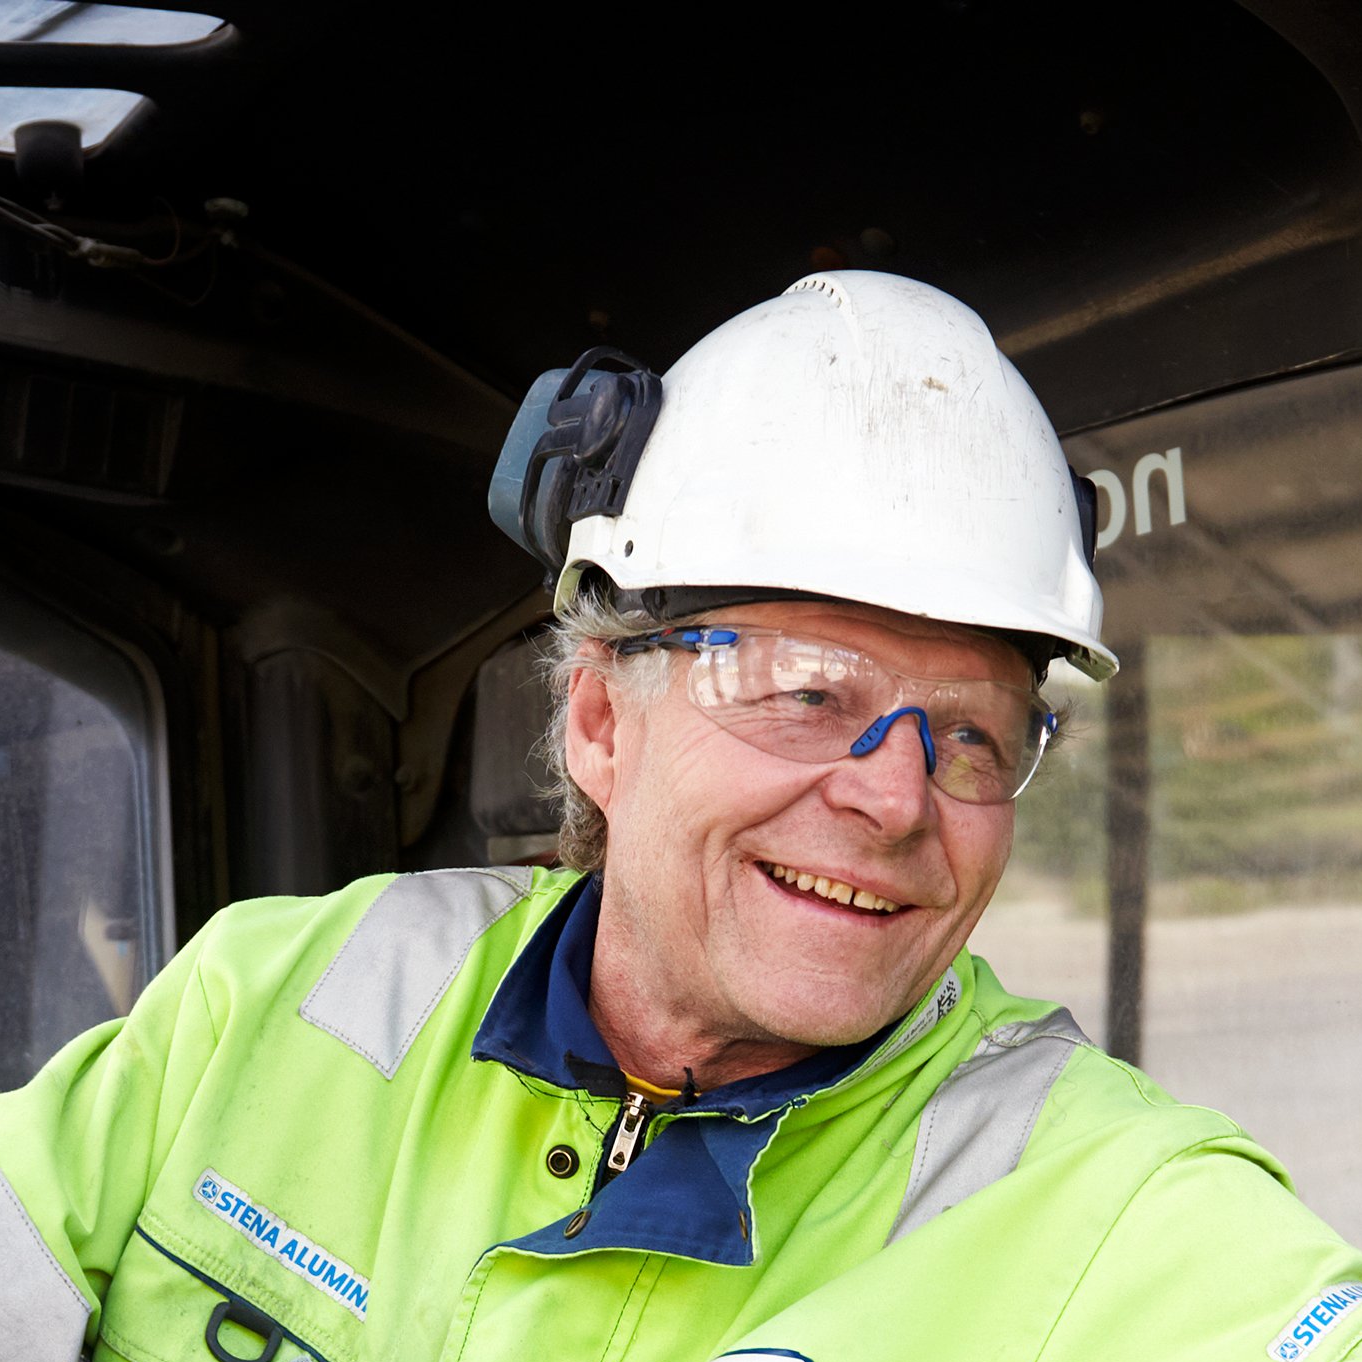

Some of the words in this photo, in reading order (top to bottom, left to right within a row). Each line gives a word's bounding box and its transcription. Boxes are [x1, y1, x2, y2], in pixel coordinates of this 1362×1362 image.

[216, 1191, 280, 1249] STENA
[279, 1238, 369, 1313] ALUMIN
[1293, 1293, 1353, 1347] STENA
